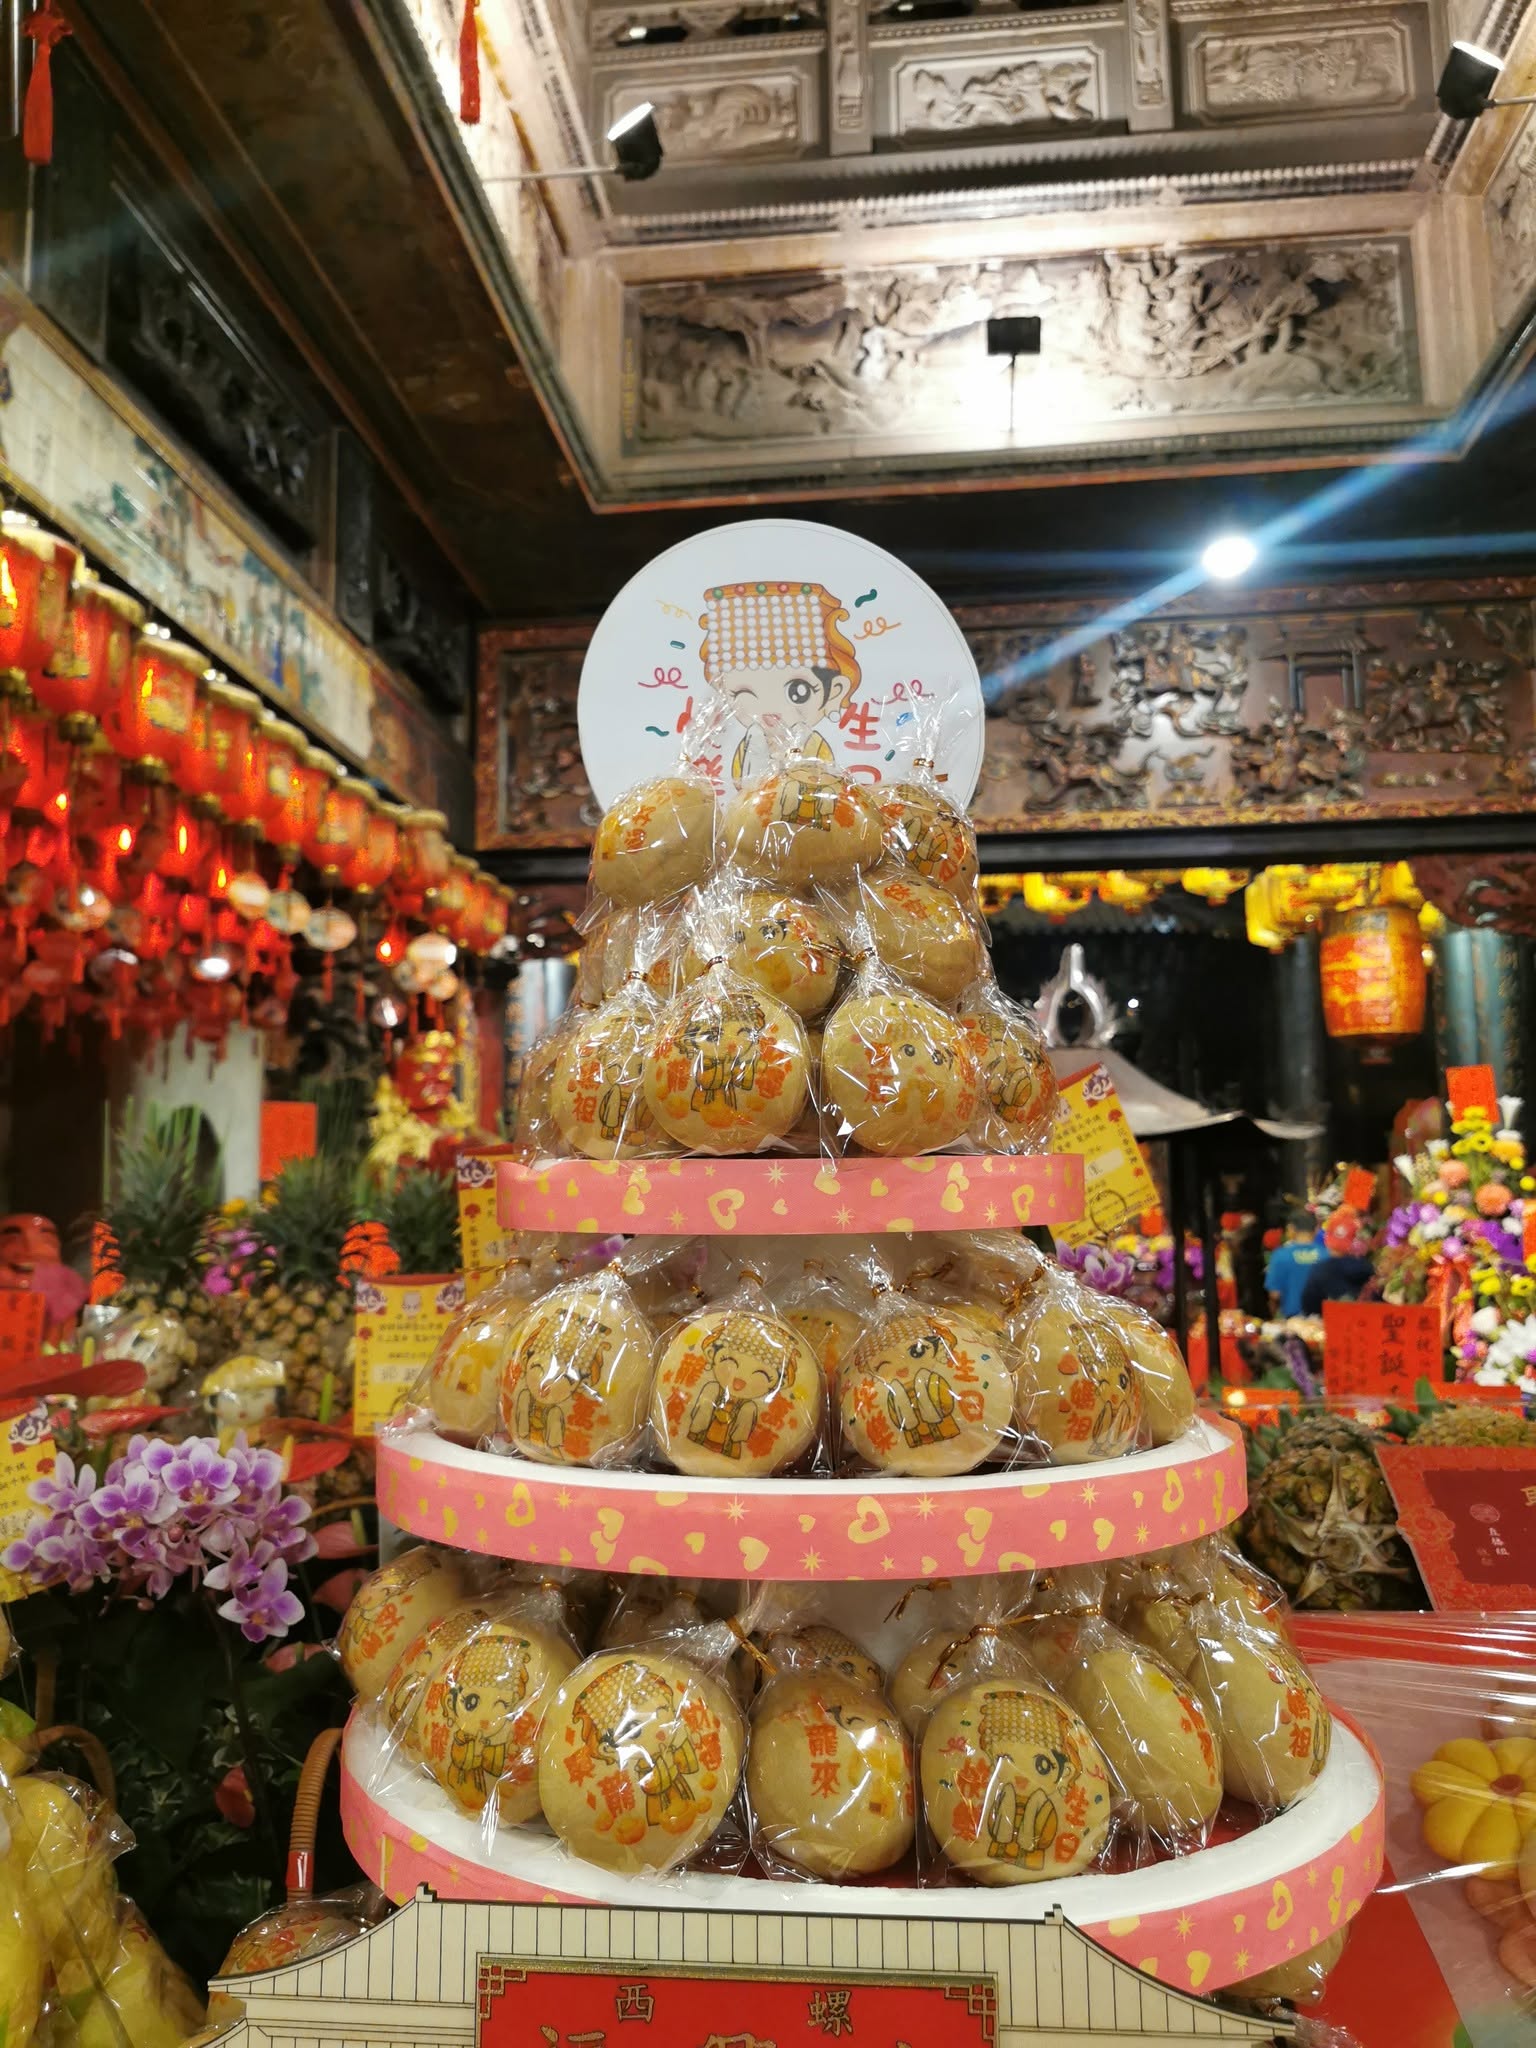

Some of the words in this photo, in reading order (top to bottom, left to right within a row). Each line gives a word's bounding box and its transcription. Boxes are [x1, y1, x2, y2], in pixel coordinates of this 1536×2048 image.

[948, 1350, 985, 1422] 生日
[804, 1723, 842, 1800] 龍來
[1053, 1785, 1090, 1864] 生日
